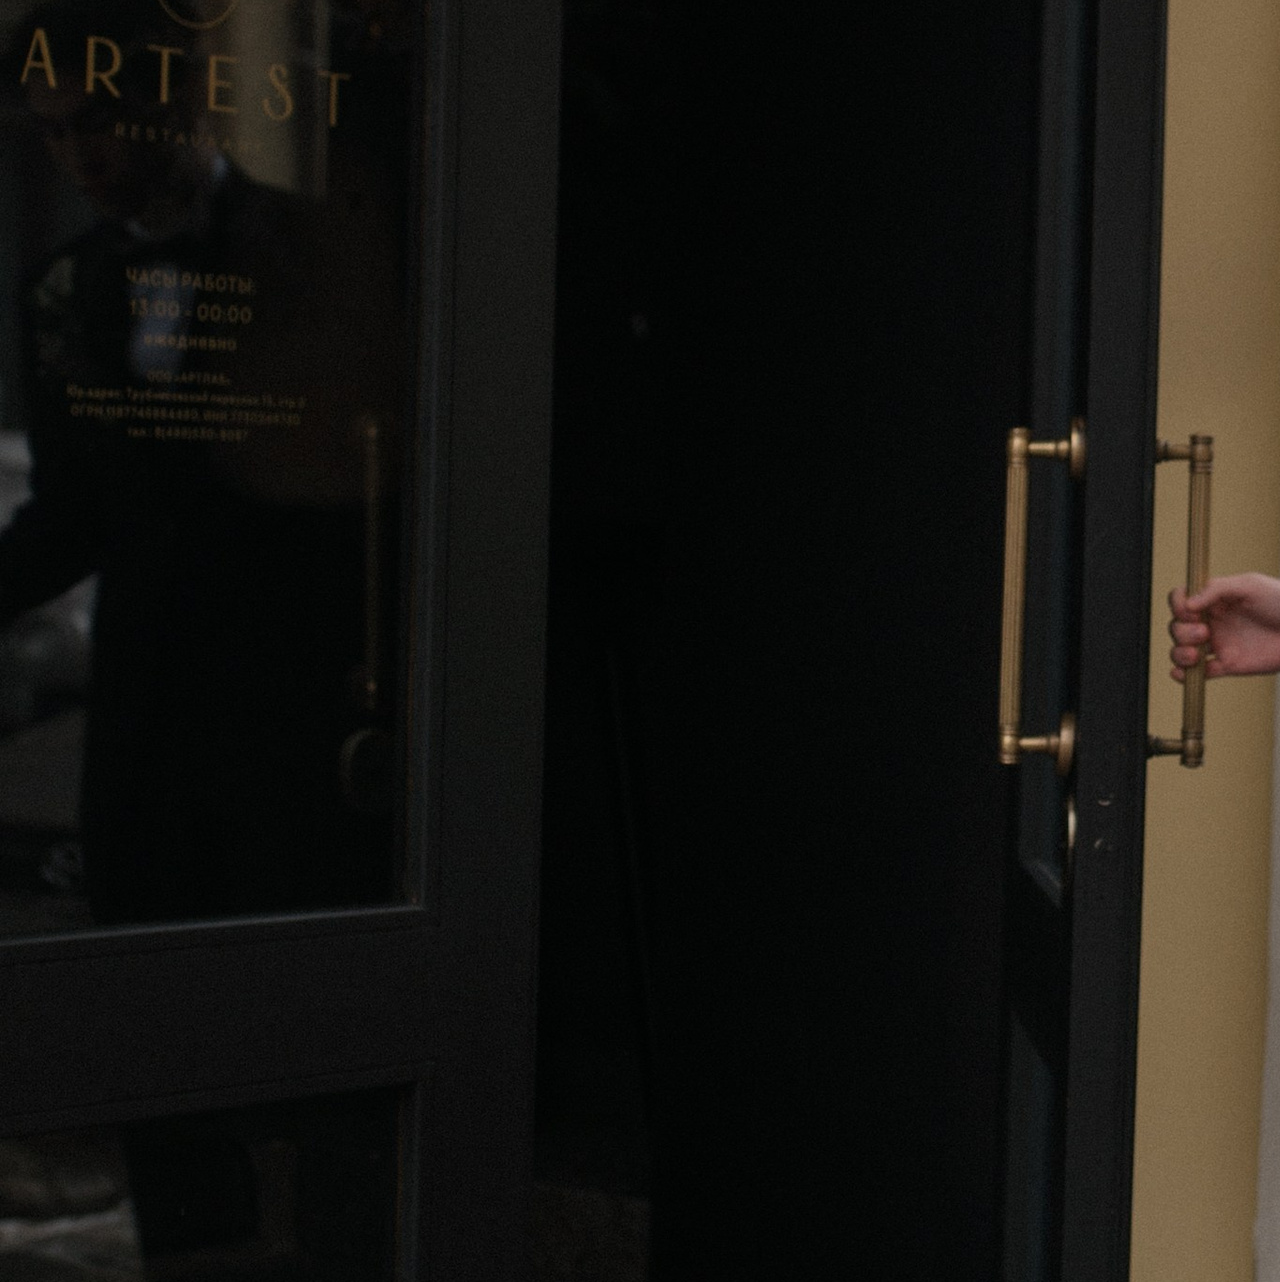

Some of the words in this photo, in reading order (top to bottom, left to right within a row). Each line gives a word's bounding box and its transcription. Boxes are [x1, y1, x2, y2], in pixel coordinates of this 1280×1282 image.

[20, 26, 351, 128] ARTEST
[125, 266, 178, 288] ЧАСЫ
[196, 302, 253, 324] 00:00
